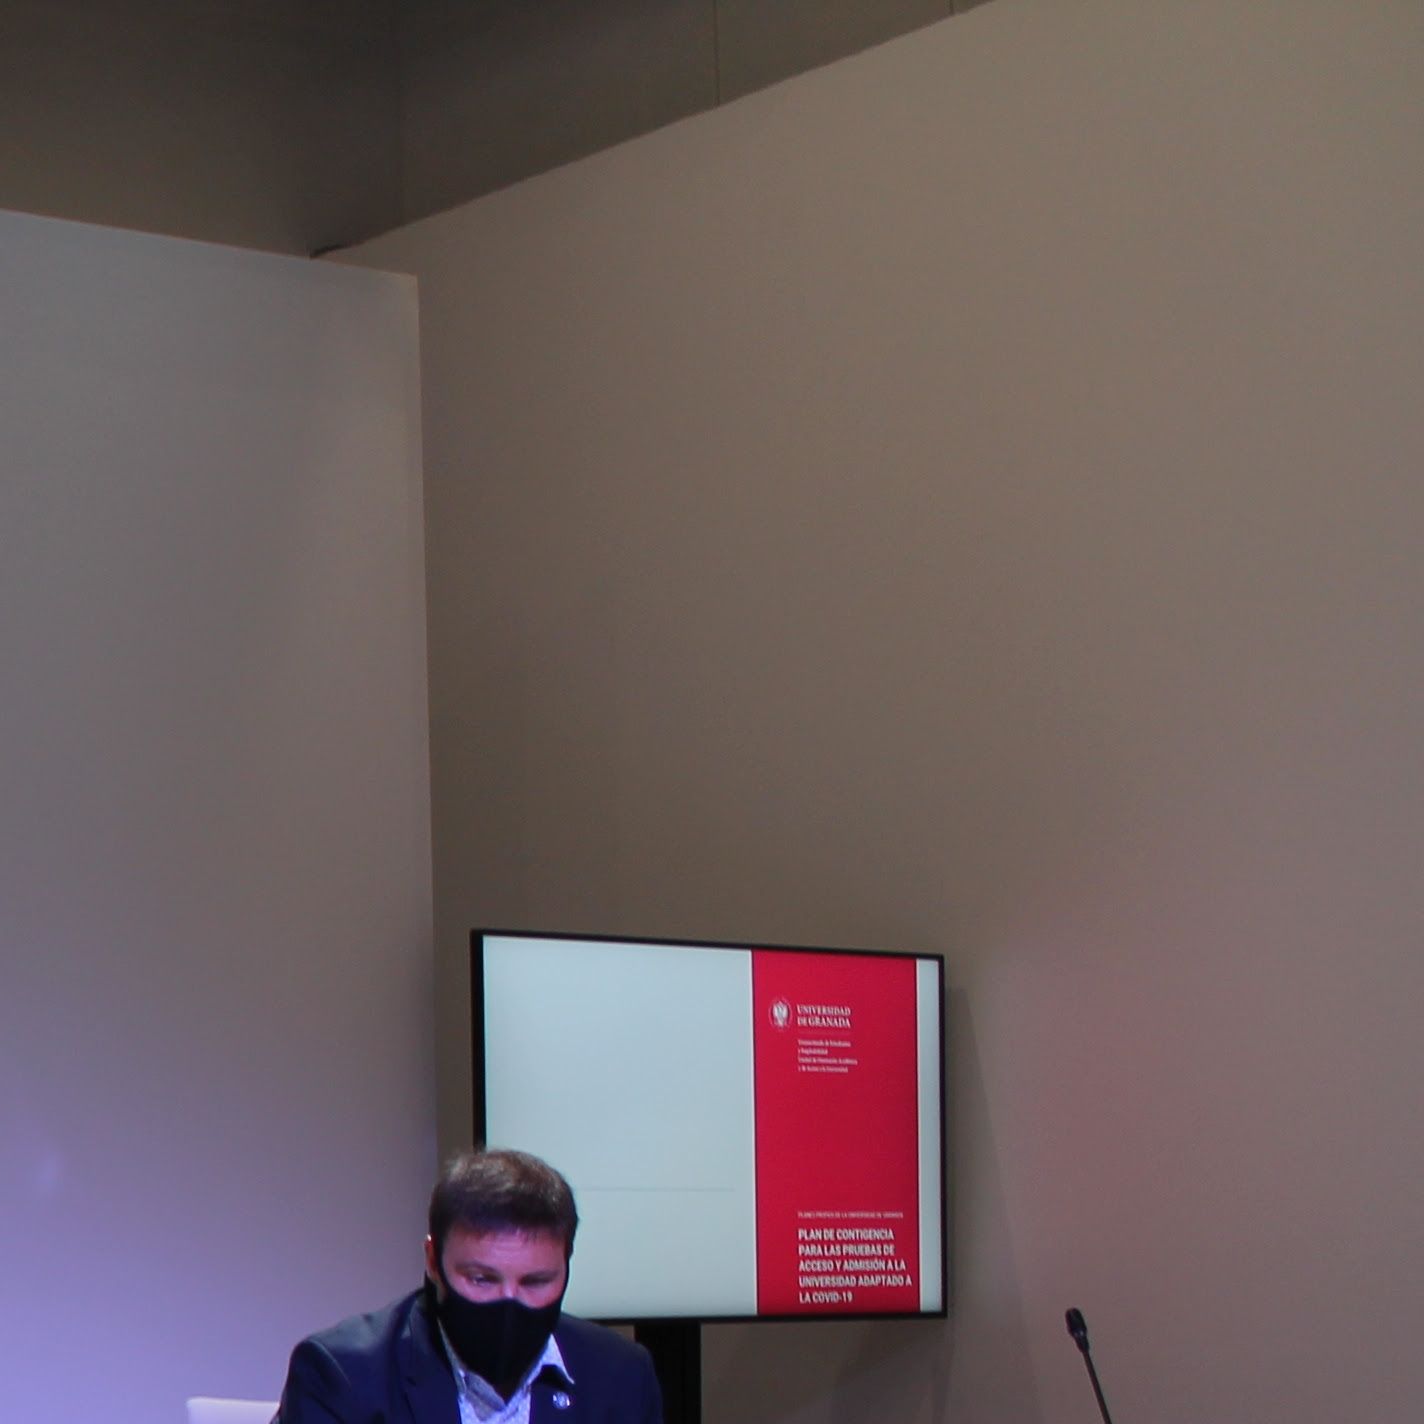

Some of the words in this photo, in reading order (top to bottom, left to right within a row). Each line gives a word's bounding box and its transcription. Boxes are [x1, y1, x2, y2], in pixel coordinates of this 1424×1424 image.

[796, 1004, 852, 1016] UNIVERSIDAD
[797, 1016, 807, 1027] DE
[808, 1016, 852, 1029] GRANADA
[798, 1228, 822, 1241] PLAN
[823, 1229, 835, 1241] DE
[836, 1229, 894, 1241] CONTIGENCIA
[798, 1244, 822, 1256] PARA
[824, 1244, 841, 1256] LAS
[842, 1244, 882, 1256] PRUEBAS
[883, 1244, 895, 1256] DE
[799, 1259, 834, 1272] ACCESO
[835, 1260, 842, 1272] Y
[843, 1258, 885, 1272] ADMISIÓN
[886, 1259, 894, 1271] A
[895, 1259, 906, 1271] LA
[799, 1275, 856, 1288] UNIVERSIDAD
[858, 1274, 904, 1287] ADAPTADO
[905, 1274, 912, 1286] A
[799, 1292, 811, 1304] LA
[812, 1291, 853, 1304] COVID-19
